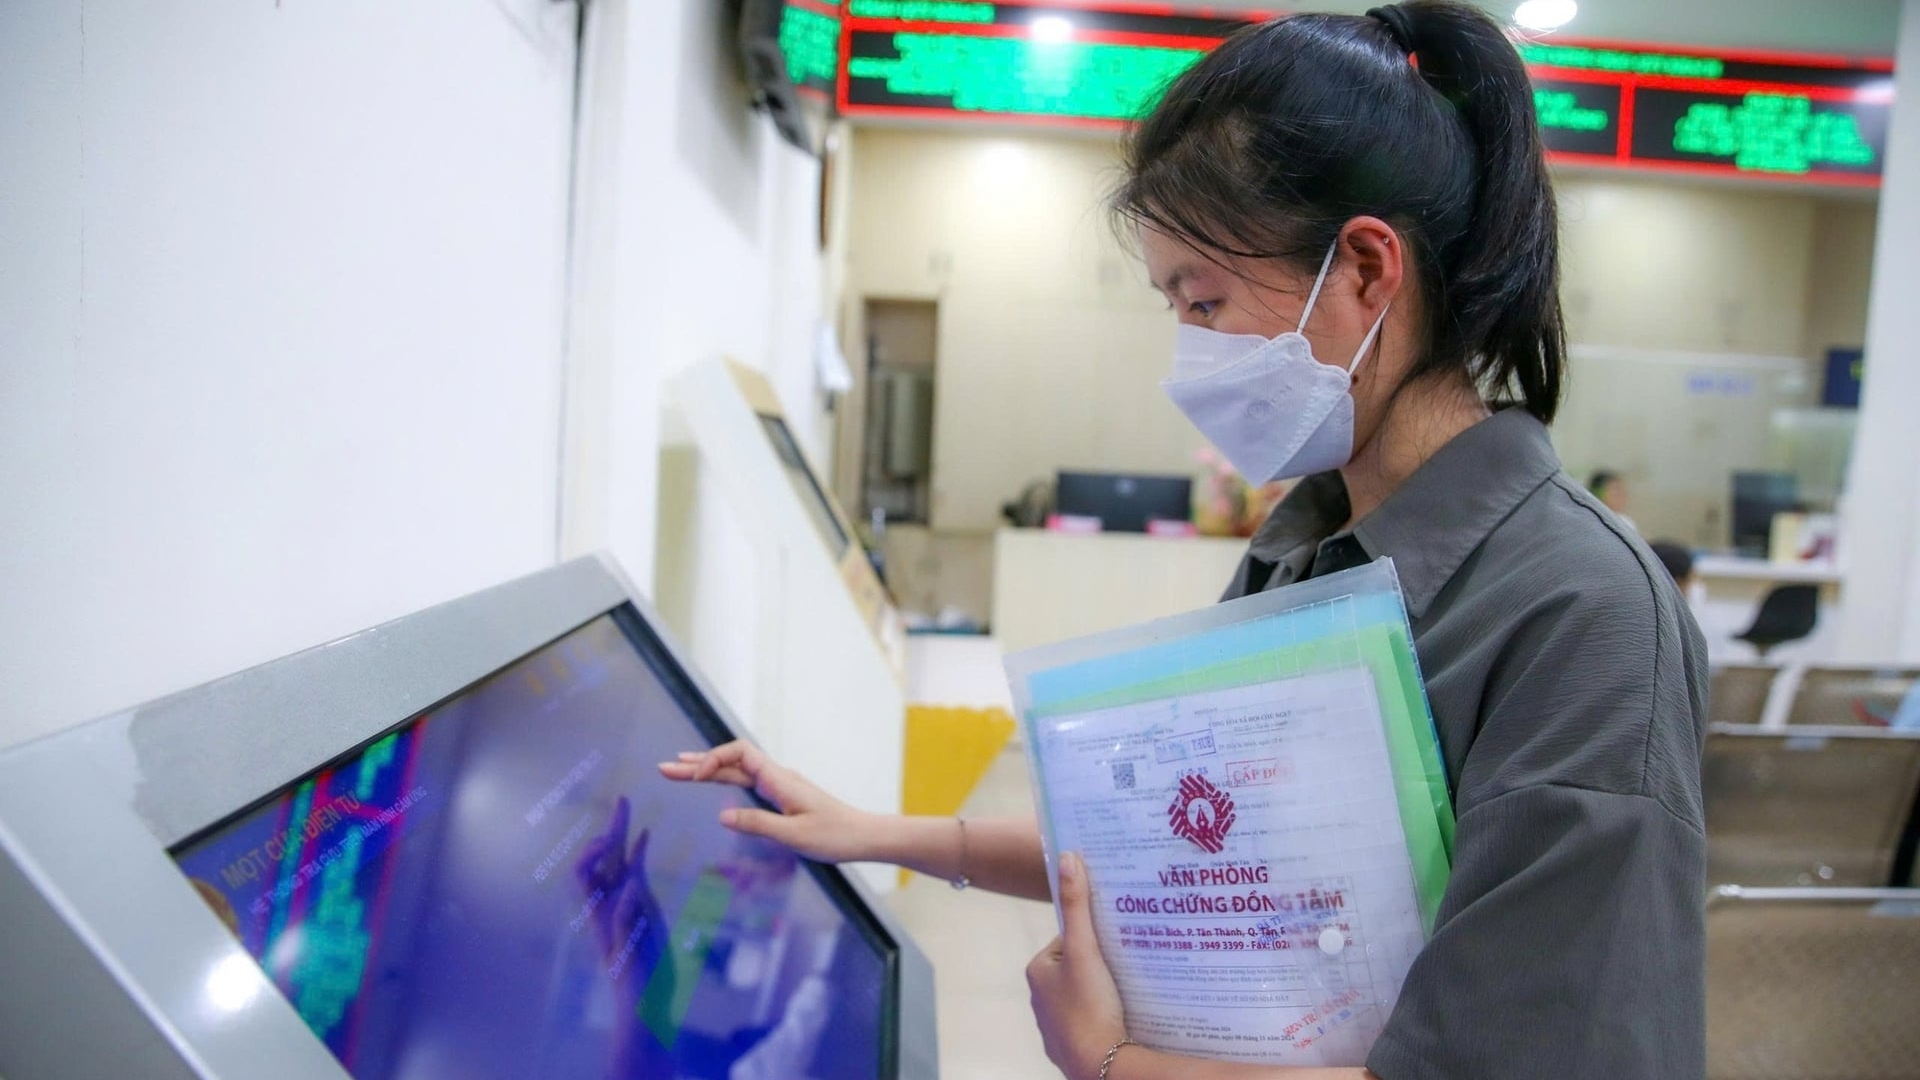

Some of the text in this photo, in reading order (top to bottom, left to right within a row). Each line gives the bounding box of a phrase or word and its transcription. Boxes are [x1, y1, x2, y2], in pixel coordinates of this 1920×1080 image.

[1233, 765, 1259, 782] CẤP
[300, 861, 322, 879] TRA
[1158, 865, 1195, 887] VĂN
[1199, 863, 1268, 886] PHÒNG
[1115, 894, 1159, 914] CÔNG
[1162, 893, 1228, 914] CHỨNG
[1295, 888, 1344, 911] TÂM
[1187, 928, 1195, 937] P.
[1197, 928, 1212, 937] Tân
[1214, 927, 1245, 938] Thành,
[1247, 927, 1258, 937] Q.
[1173, 941, 1193, 950] 3388
[1199, 941, 1221, 950] 3949
[1222, 941, 1244, 950] 3399
[1251, 940, 1270, 950] Fax:
